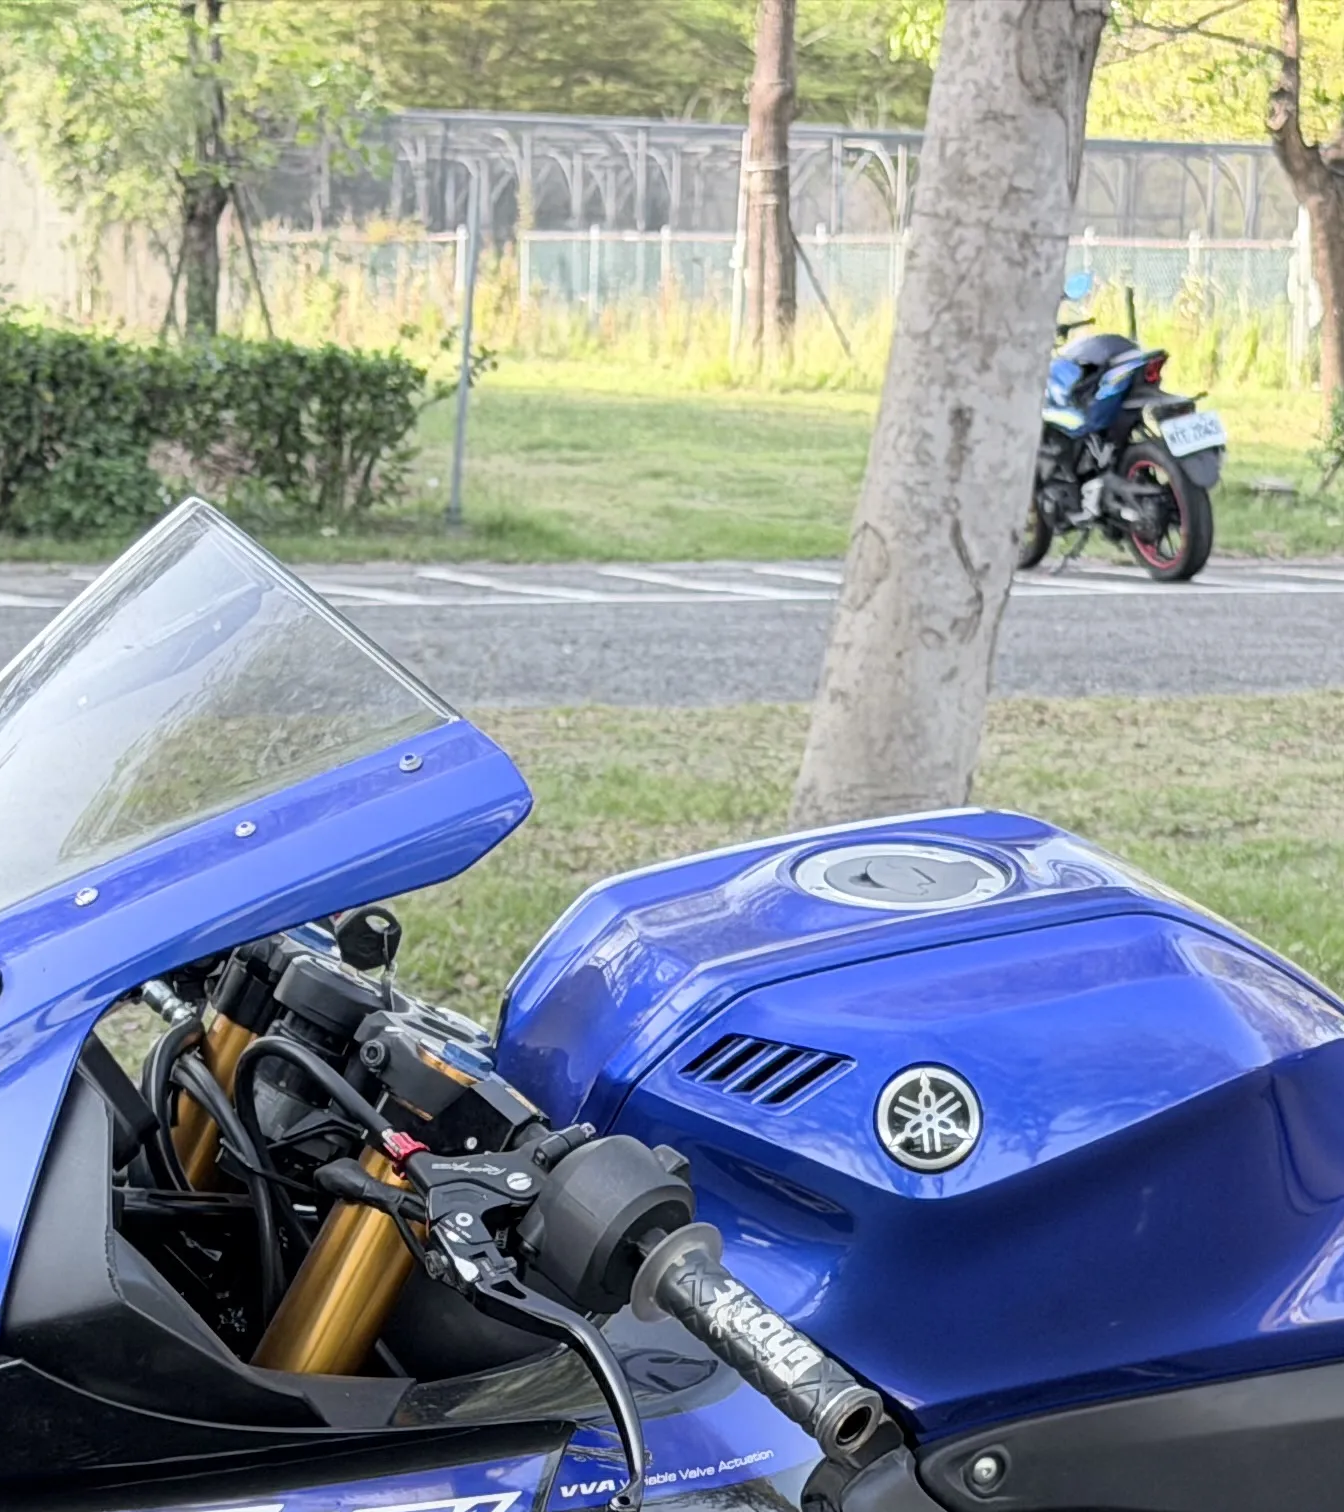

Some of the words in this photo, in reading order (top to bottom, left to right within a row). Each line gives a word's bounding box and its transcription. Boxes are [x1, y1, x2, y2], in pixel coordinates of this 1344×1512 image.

[559, 1478, 617, 1499] VVA
[619, 1471, 677, 1490] Viable
[677, 1464, 716, 1482] Valve
[718, 1448, 775, 1474] Actuation
